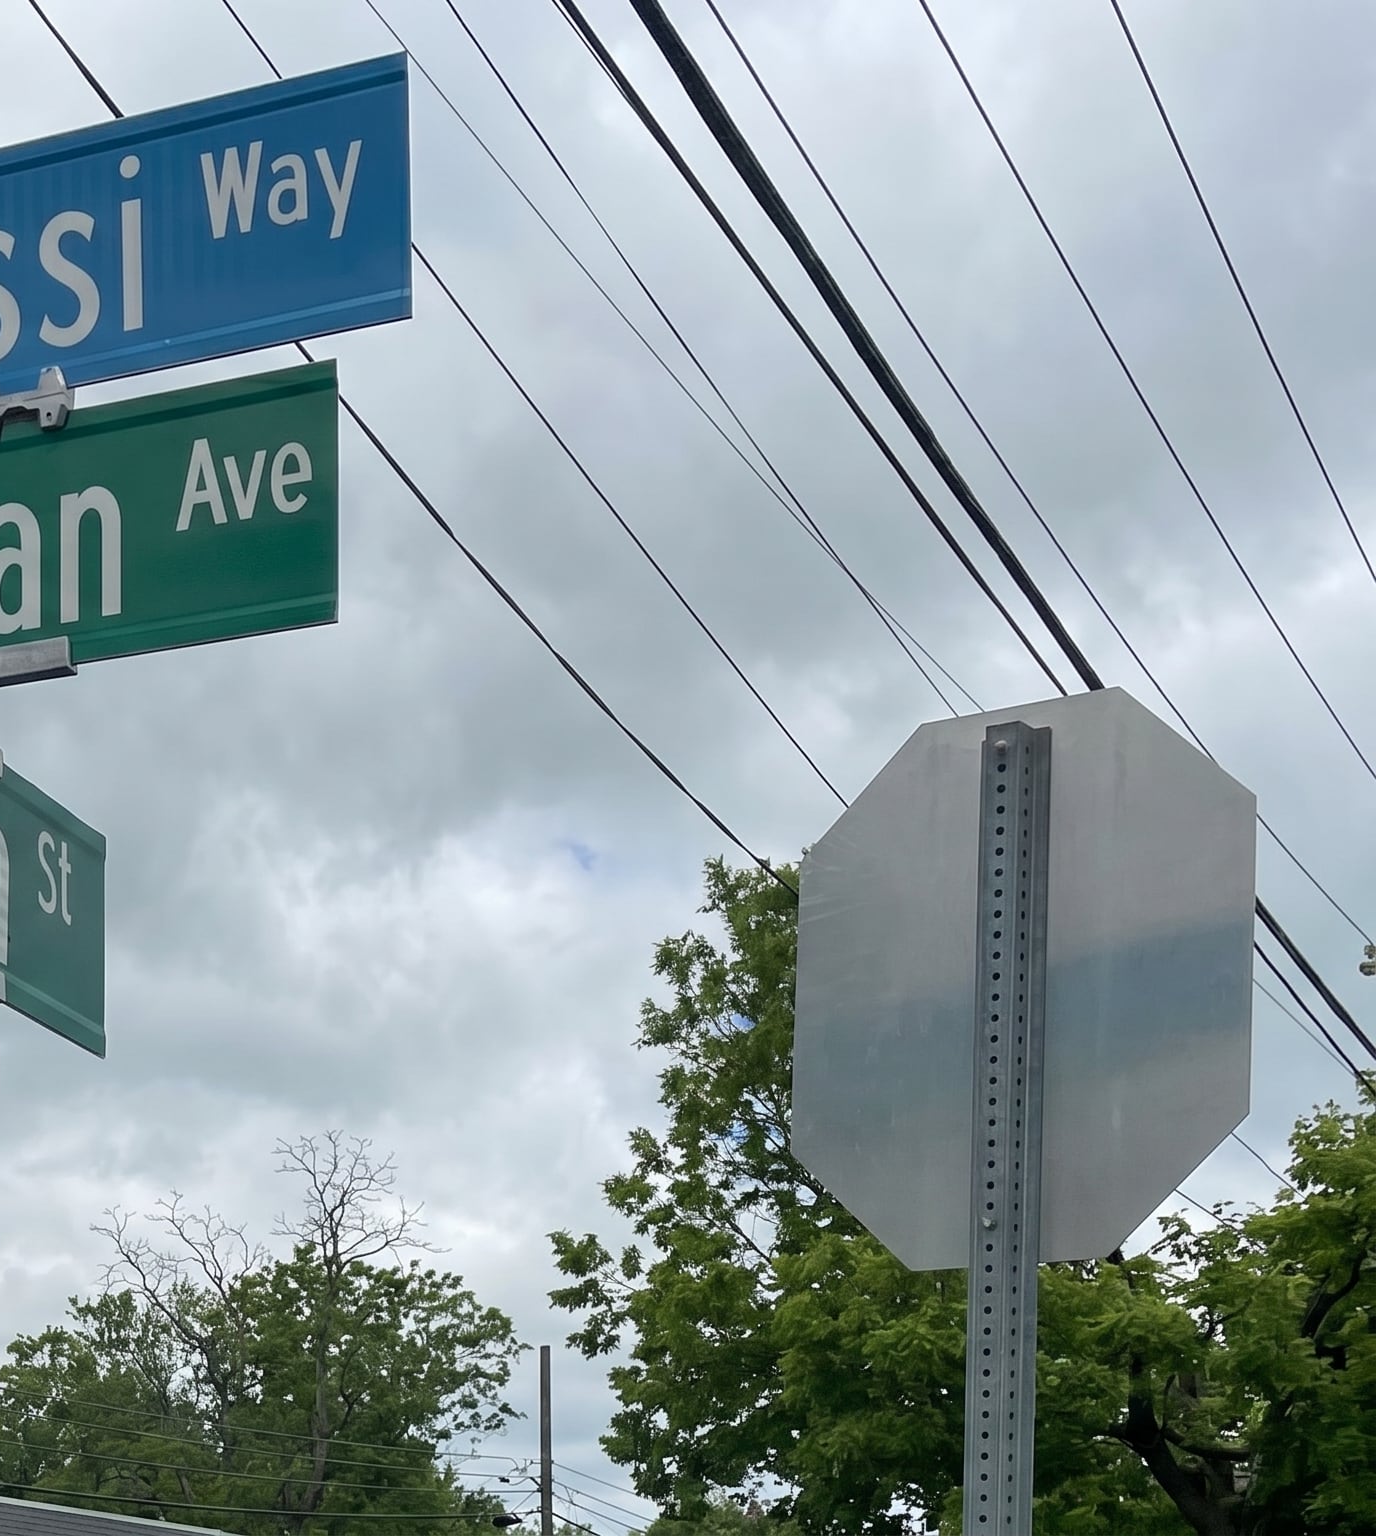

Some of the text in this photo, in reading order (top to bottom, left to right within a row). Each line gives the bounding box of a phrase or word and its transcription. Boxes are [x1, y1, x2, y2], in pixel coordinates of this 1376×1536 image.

[200, 140, 361, 239] Way
[176, 438, 312, 532] Ave
[37, 831, 72, 926] St
